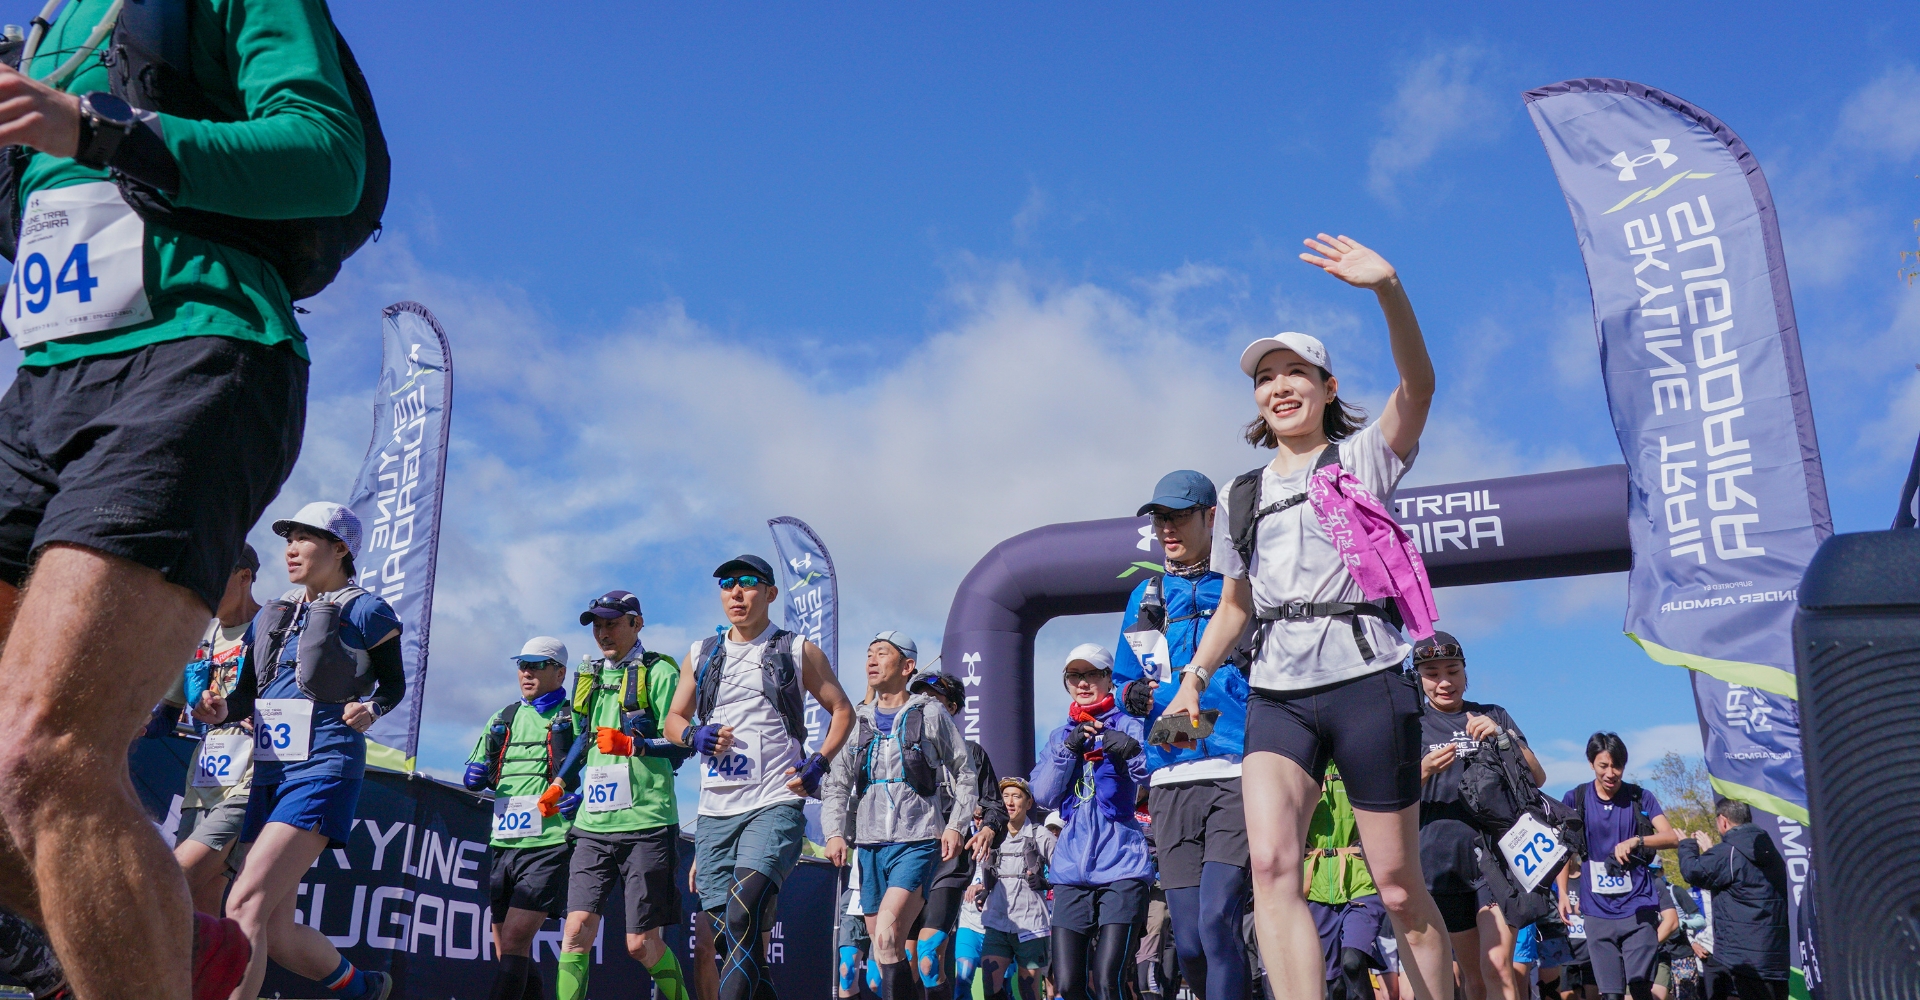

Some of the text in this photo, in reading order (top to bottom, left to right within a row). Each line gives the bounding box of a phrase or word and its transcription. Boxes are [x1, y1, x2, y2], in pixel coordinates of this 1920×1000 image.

[43, 210, 68, 220] TRAIL
[13, 243, 98, 319] 194
[1395, 490, 1500, 518] TRAIL
[254, 723, 291, 749] 163
[201, 755, 231, 778] 162
[708, 754, 748, 777] 242
[589, 782, 618, 803] 267
[498, 812, 531, 830] 202
[1514, 832, 1554, 876] 273
[1597, 874, 1624, 887] 236
